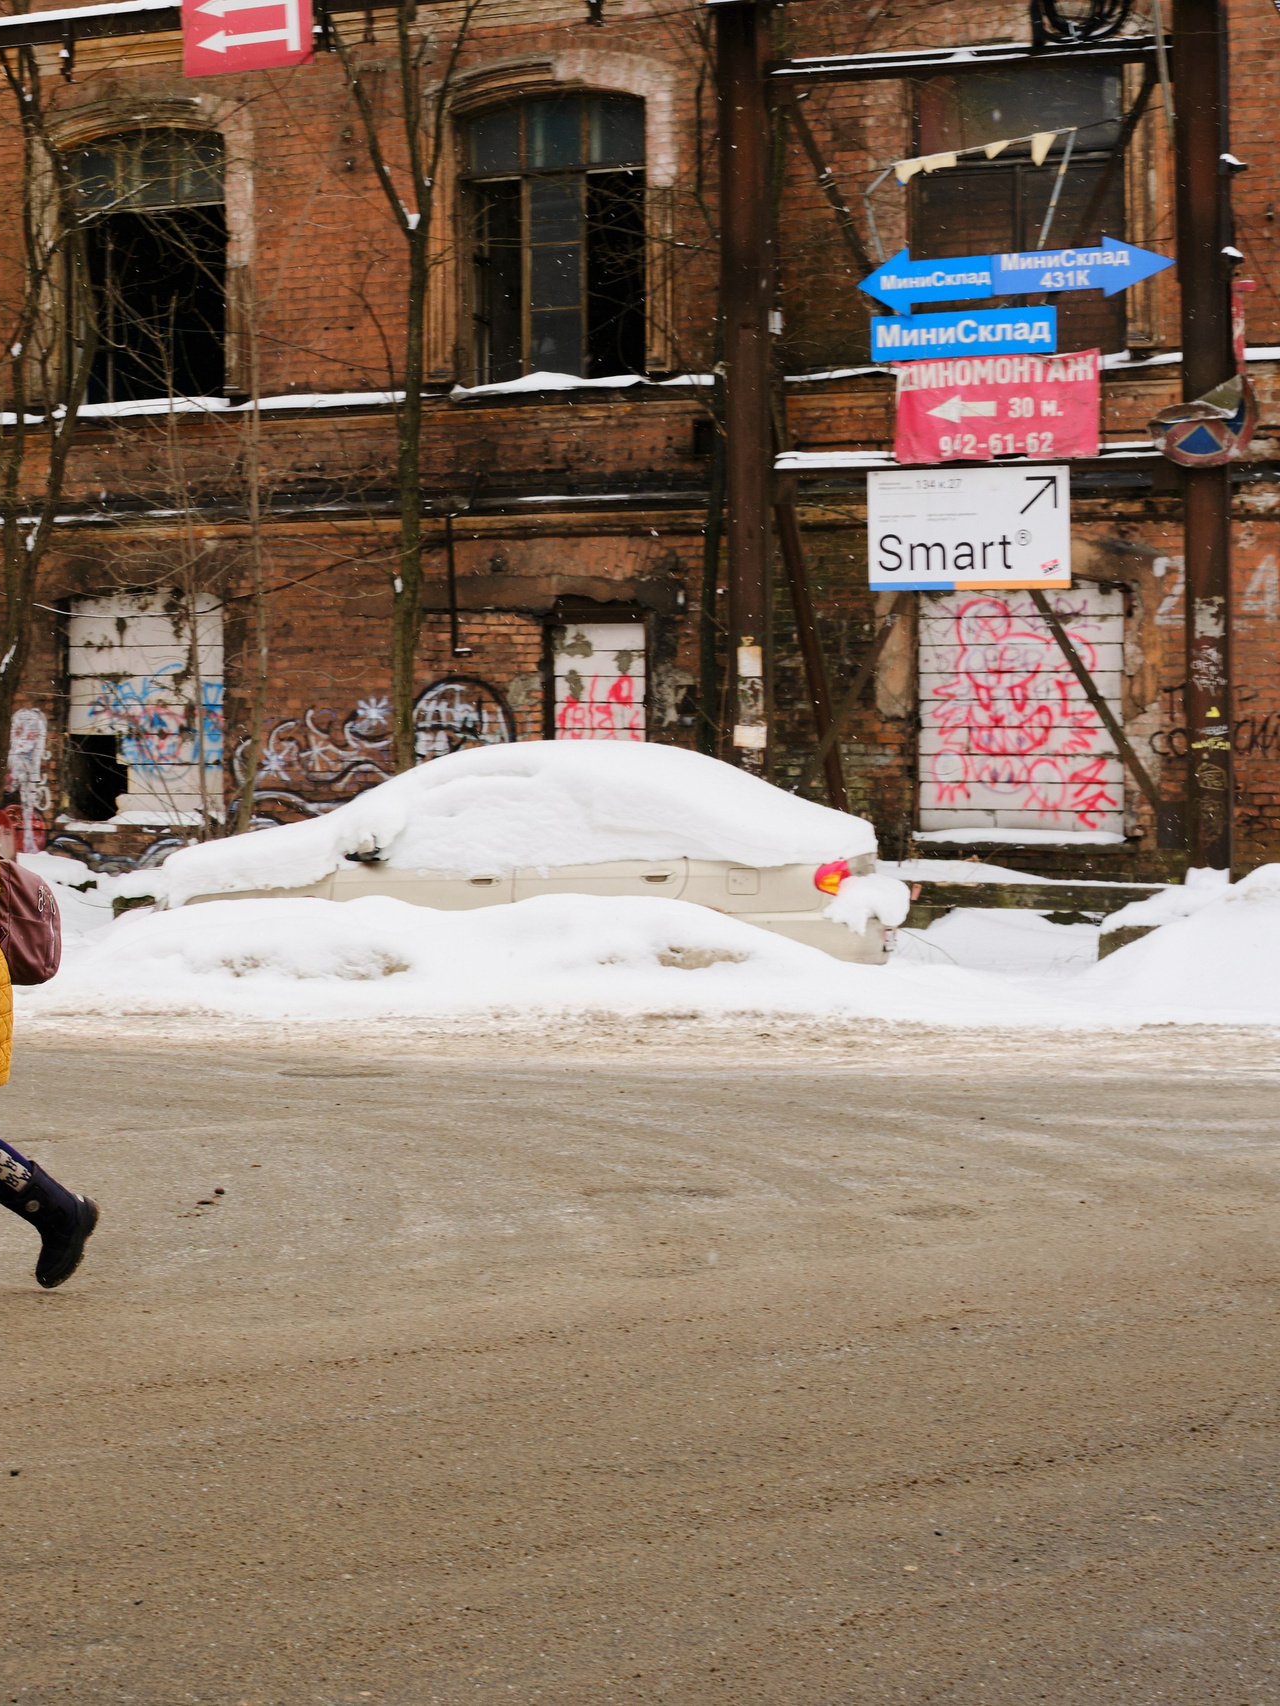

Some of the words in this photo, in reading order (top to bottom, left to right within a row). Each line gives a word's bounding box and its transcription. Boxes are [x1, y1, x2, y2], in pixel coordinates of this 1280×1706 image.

[1001, 250, 1130, 271] МиниСклад
[880, 270, 991, 290] МиниСклад
[1040, 270, 1090, 288] 431К
[876, 319, 1051, 348] МиниСклад
[1008, 397, 1035, 418] 30
[1040, 400, 1064, 417] м.
